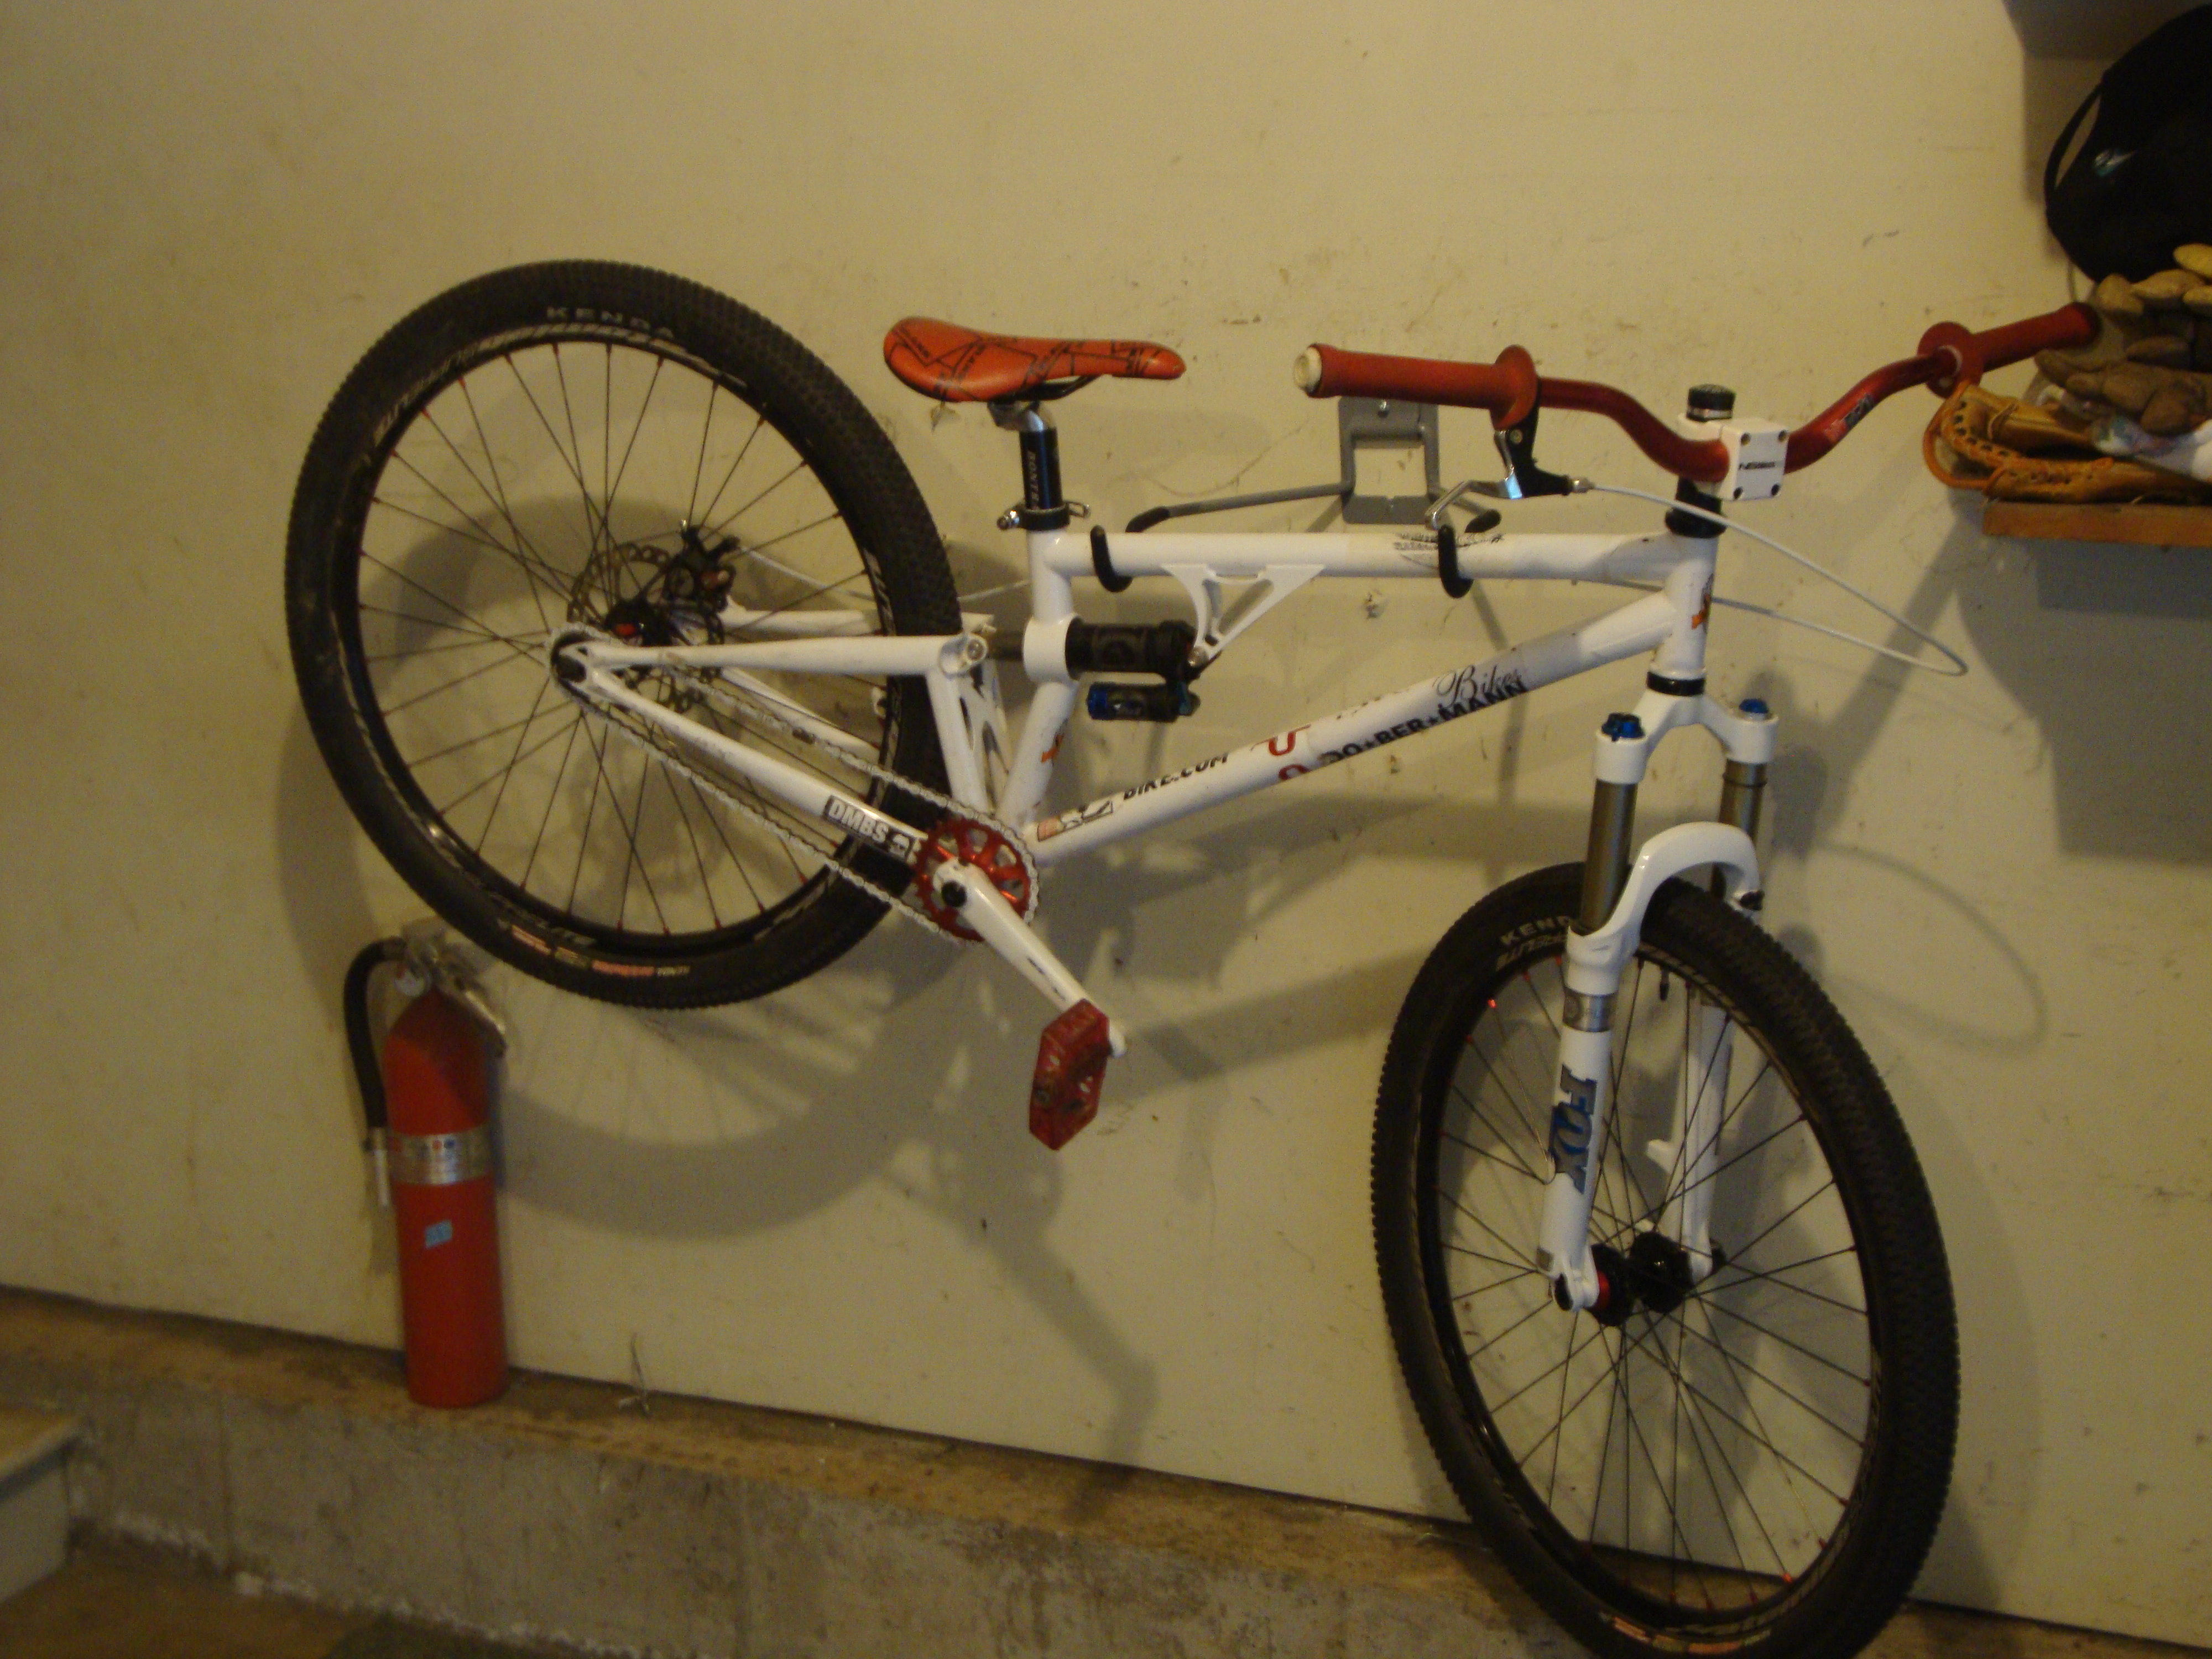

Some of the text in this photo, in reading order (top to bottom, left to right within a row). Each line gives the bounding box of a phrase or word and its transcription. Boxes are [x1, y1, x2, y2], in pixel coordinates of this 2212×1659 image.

[827, 797, 890, 844] DMBS
[1500, 915, 1572, 946] KEND
[1550, 1063, 1597, 1195] FOX
